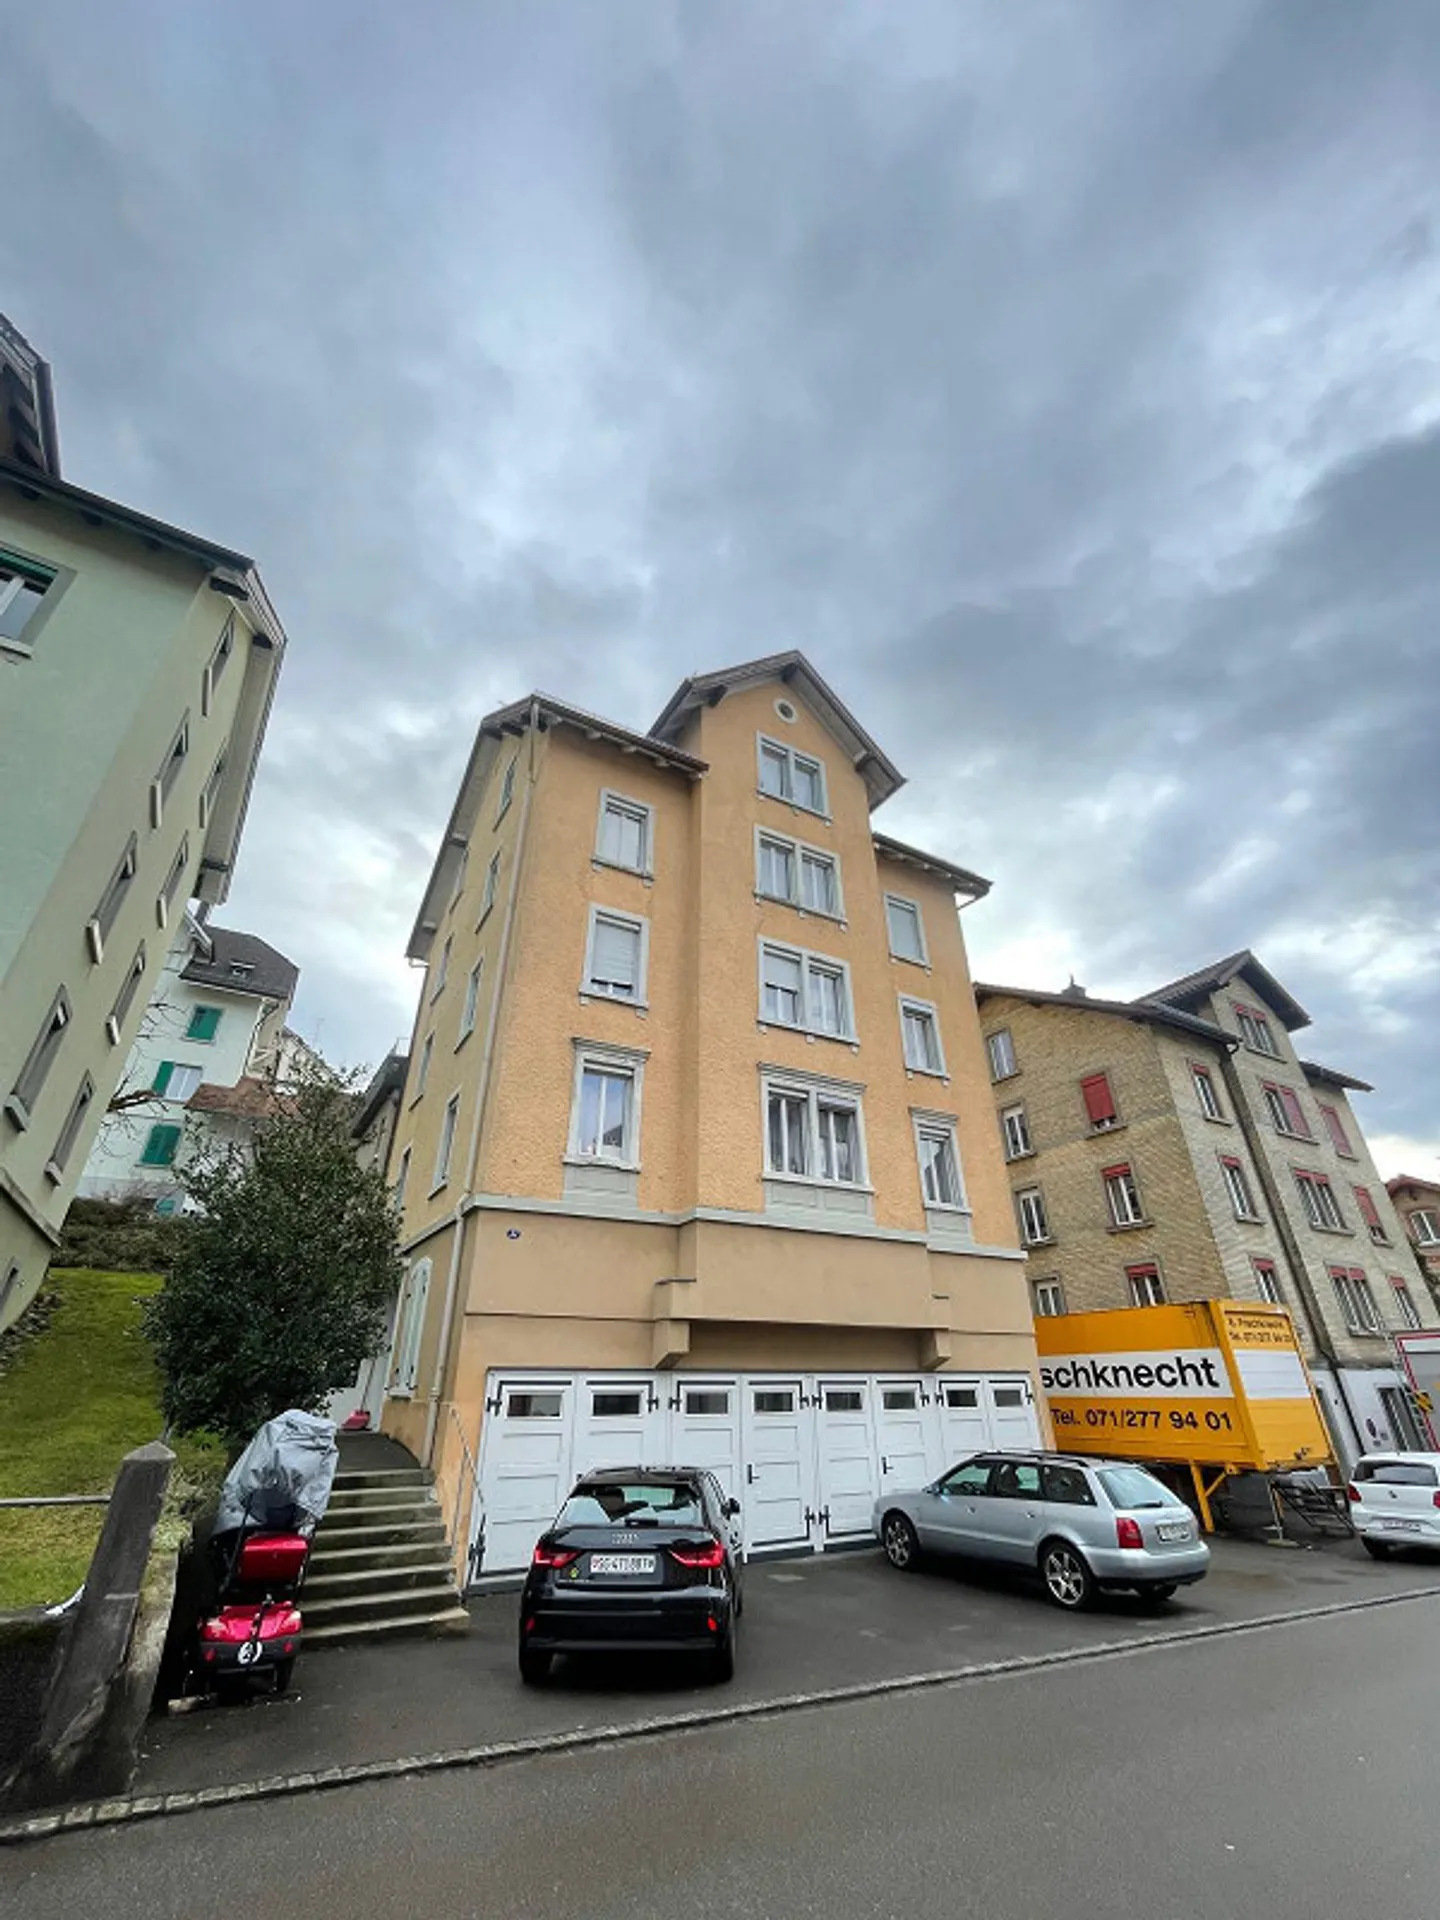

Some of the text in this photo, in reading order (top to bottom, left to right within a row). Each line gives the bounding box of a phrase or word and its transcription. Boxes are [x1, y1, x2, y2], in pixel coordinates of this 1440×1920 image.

[1051, 1408, 1232, 1430] Tel. 071/277 94 01
